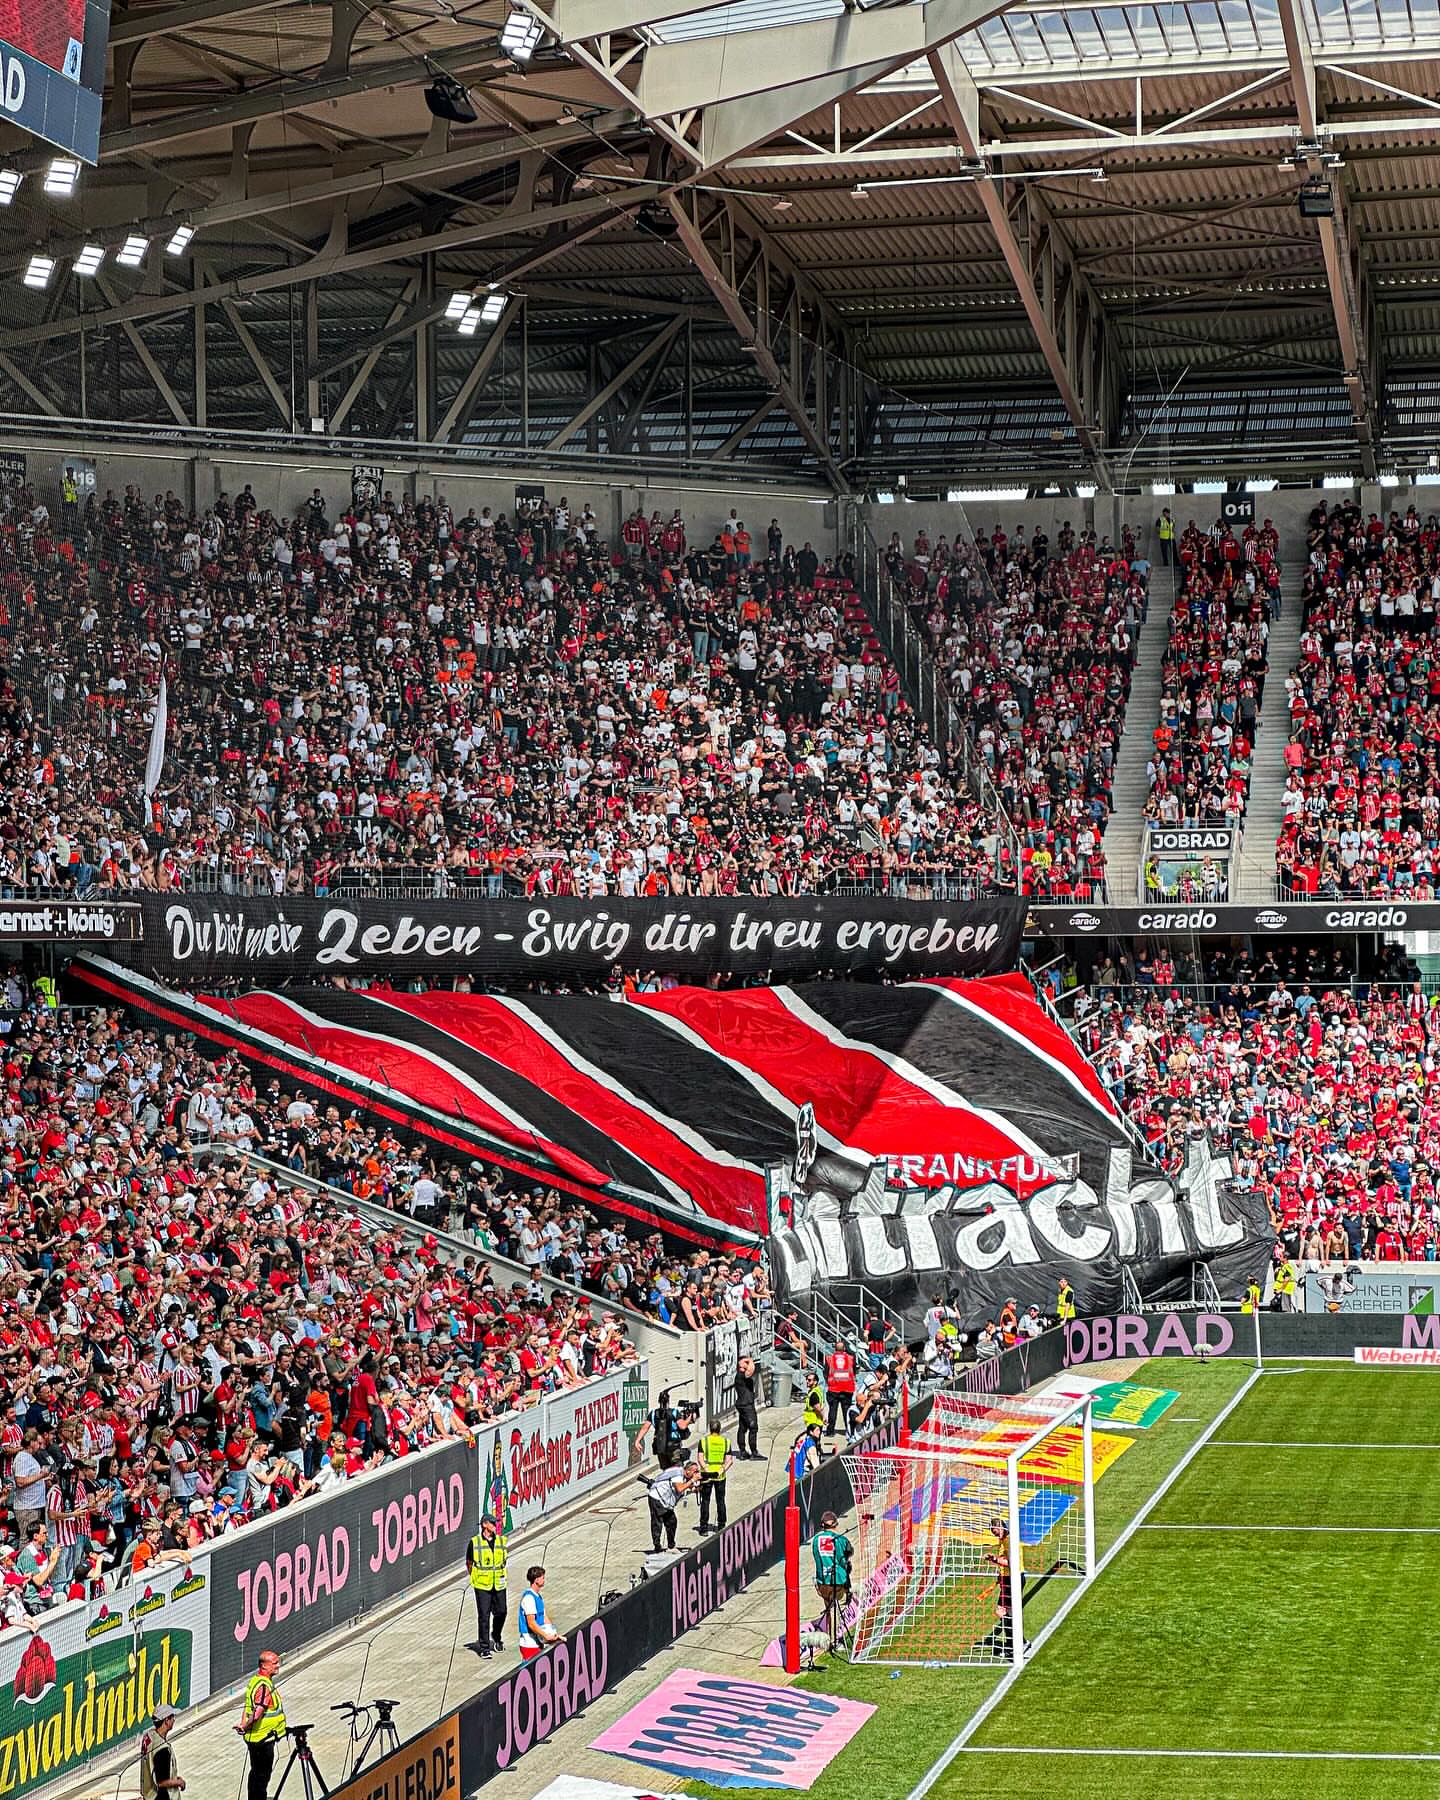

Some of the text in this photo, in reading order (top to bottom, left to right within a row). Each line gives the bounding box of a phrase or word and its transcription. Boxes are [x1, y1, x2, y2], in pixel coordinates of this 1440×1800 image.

[1153, 832, 1230, 849] JOBRAD
[0, 908, 115, 937] ernst+könig
[166, 904, 212, 960] Du
[213, 912, 244, 955] bist
[245, 912, 303, 960] mein
[521, 908, 631, 961] Ewig
[645, 913, 717, 953] dir
[730, 912, 823, 951] treu
[836, 917, 1001, 962] ergeben
[1069, 916, 1101, 926] carado
[1138, 908, 1218, 929] carado
[1254, 913, 1288, 925] carado
[1325, 906, 1408, 928] carado
[1343, 1300, 1402, 1311] ABERER
[1355, 1284, 1402, 1297] HNER
[1063, 1314, 1235, 1369] JOBRAD
[574, 1390, 620, 1440] TANNEN
[508, 1427, 573, 1511] Rothaus
[576, 1431, 619, 1480] ZÄPFLE
[370, 1472, 465, 1573] JOBRAD
[233, 1525, 350, 1642] JOBRAD
[671, 1550, 713, 1638] Mein
[496, 1618, 608, 1768] JOBRAD
